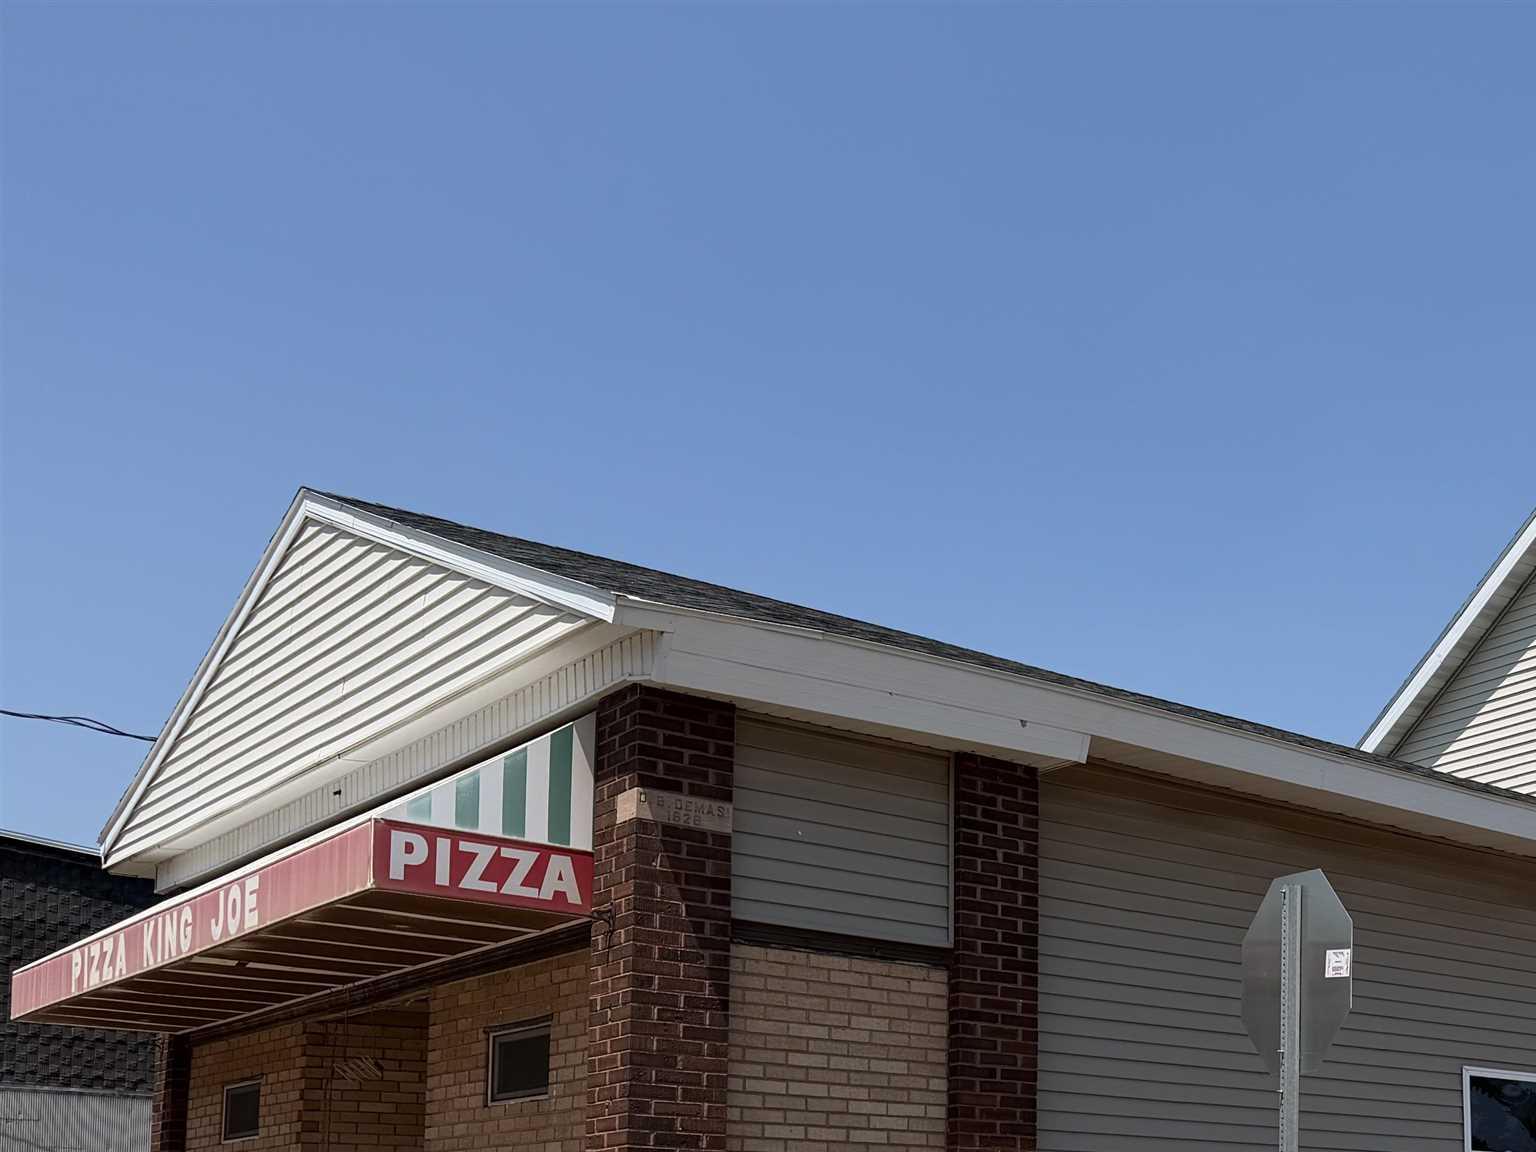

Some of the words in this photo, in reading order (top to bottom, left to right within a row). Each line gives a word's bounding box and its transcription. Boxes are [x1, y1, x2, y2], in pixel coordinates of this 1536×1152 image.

[389, 829, 582, 905] PIZZA
[71, 931, 127, 993] PIZZA
[143, 905, 193, 968] KING
[211, 875, 260, 941] JOE
